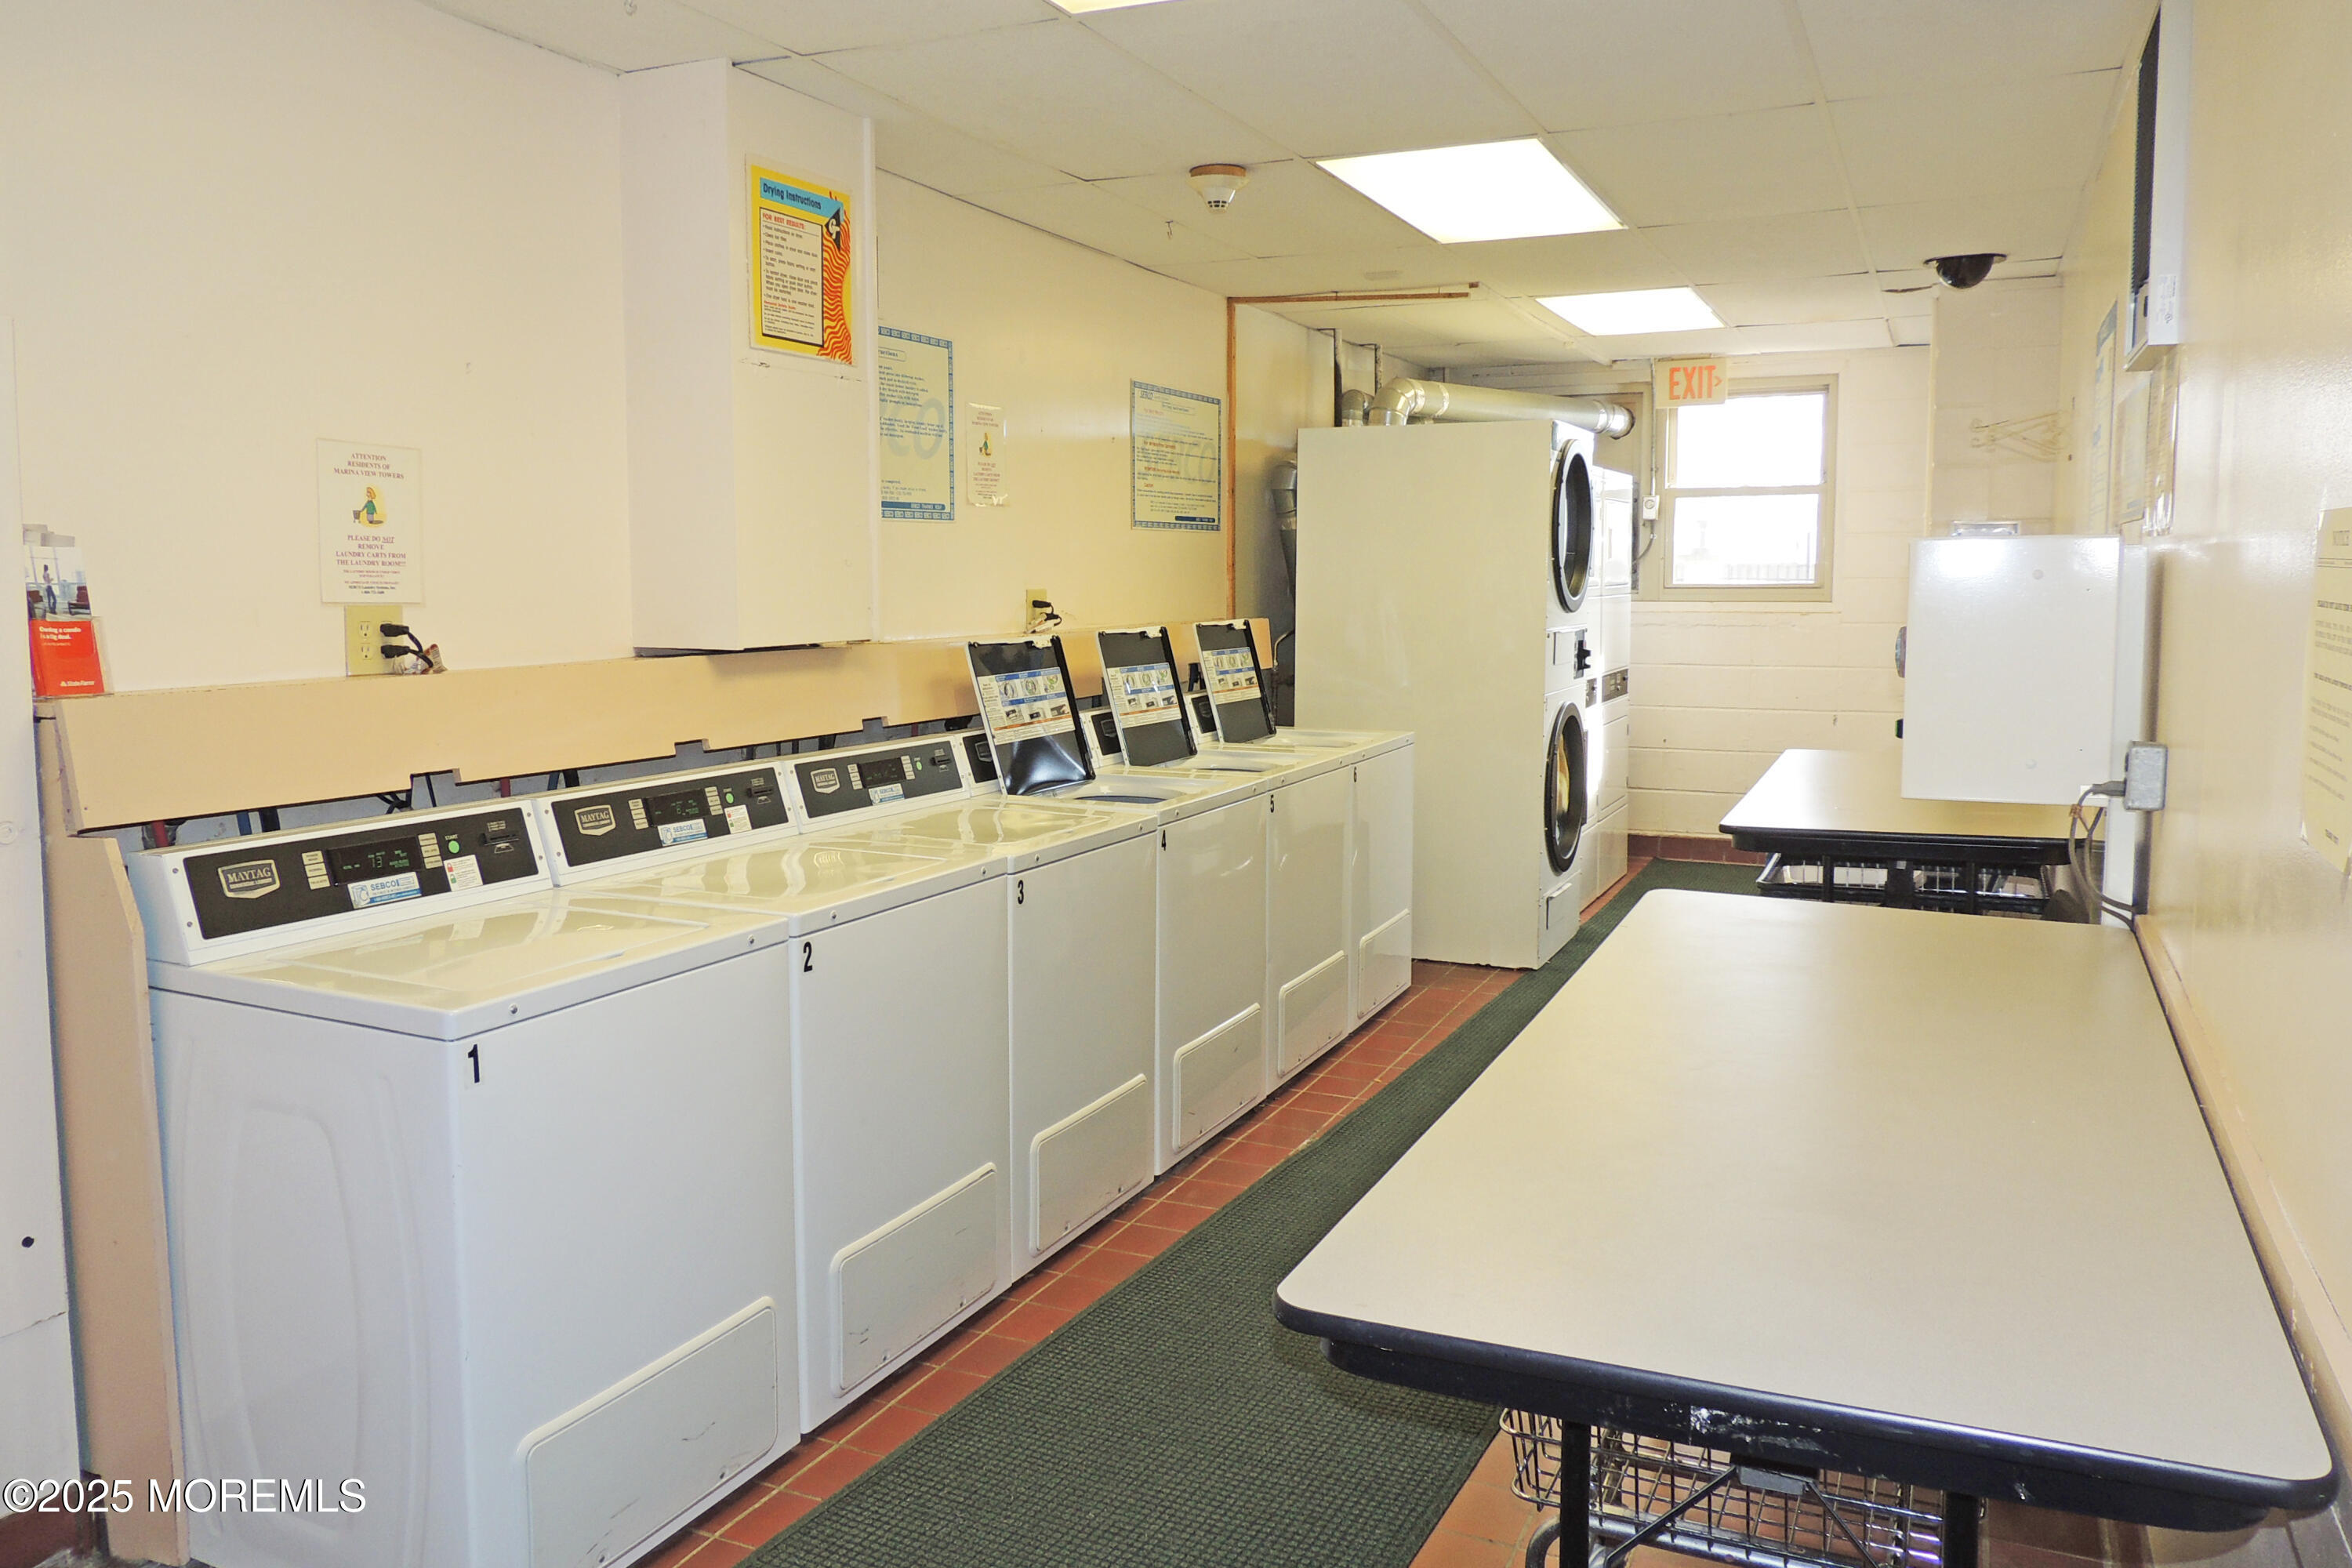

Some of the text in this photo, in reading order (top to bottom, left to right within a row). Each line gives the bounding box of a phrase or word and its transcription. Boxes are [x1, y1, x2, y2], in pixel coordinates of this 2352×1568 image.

[763, 183, 822, 210] Drying Instructions
[1669, 365, 1717, 401] EXIT
[347, 460, 381, 470] RESIDENTS
[351, 452, 387, 461] ATTENTION
[334, 467, 359, 476] MARINA
[1353, 767, 1357, 783] 6
[1270, 794, 1275, 813] 5
[580, 811, 610, 822] MAYTAG
[1161, 829, 1167, 851] 4
[227, 867, 270, 883] MAYTAG
[371, 880, 396, 891] SEBCO
[1018, 880, 1025, 905] 3
[804, 941, 813, 973] 2
[468, 1044, 480, 1083] 1
